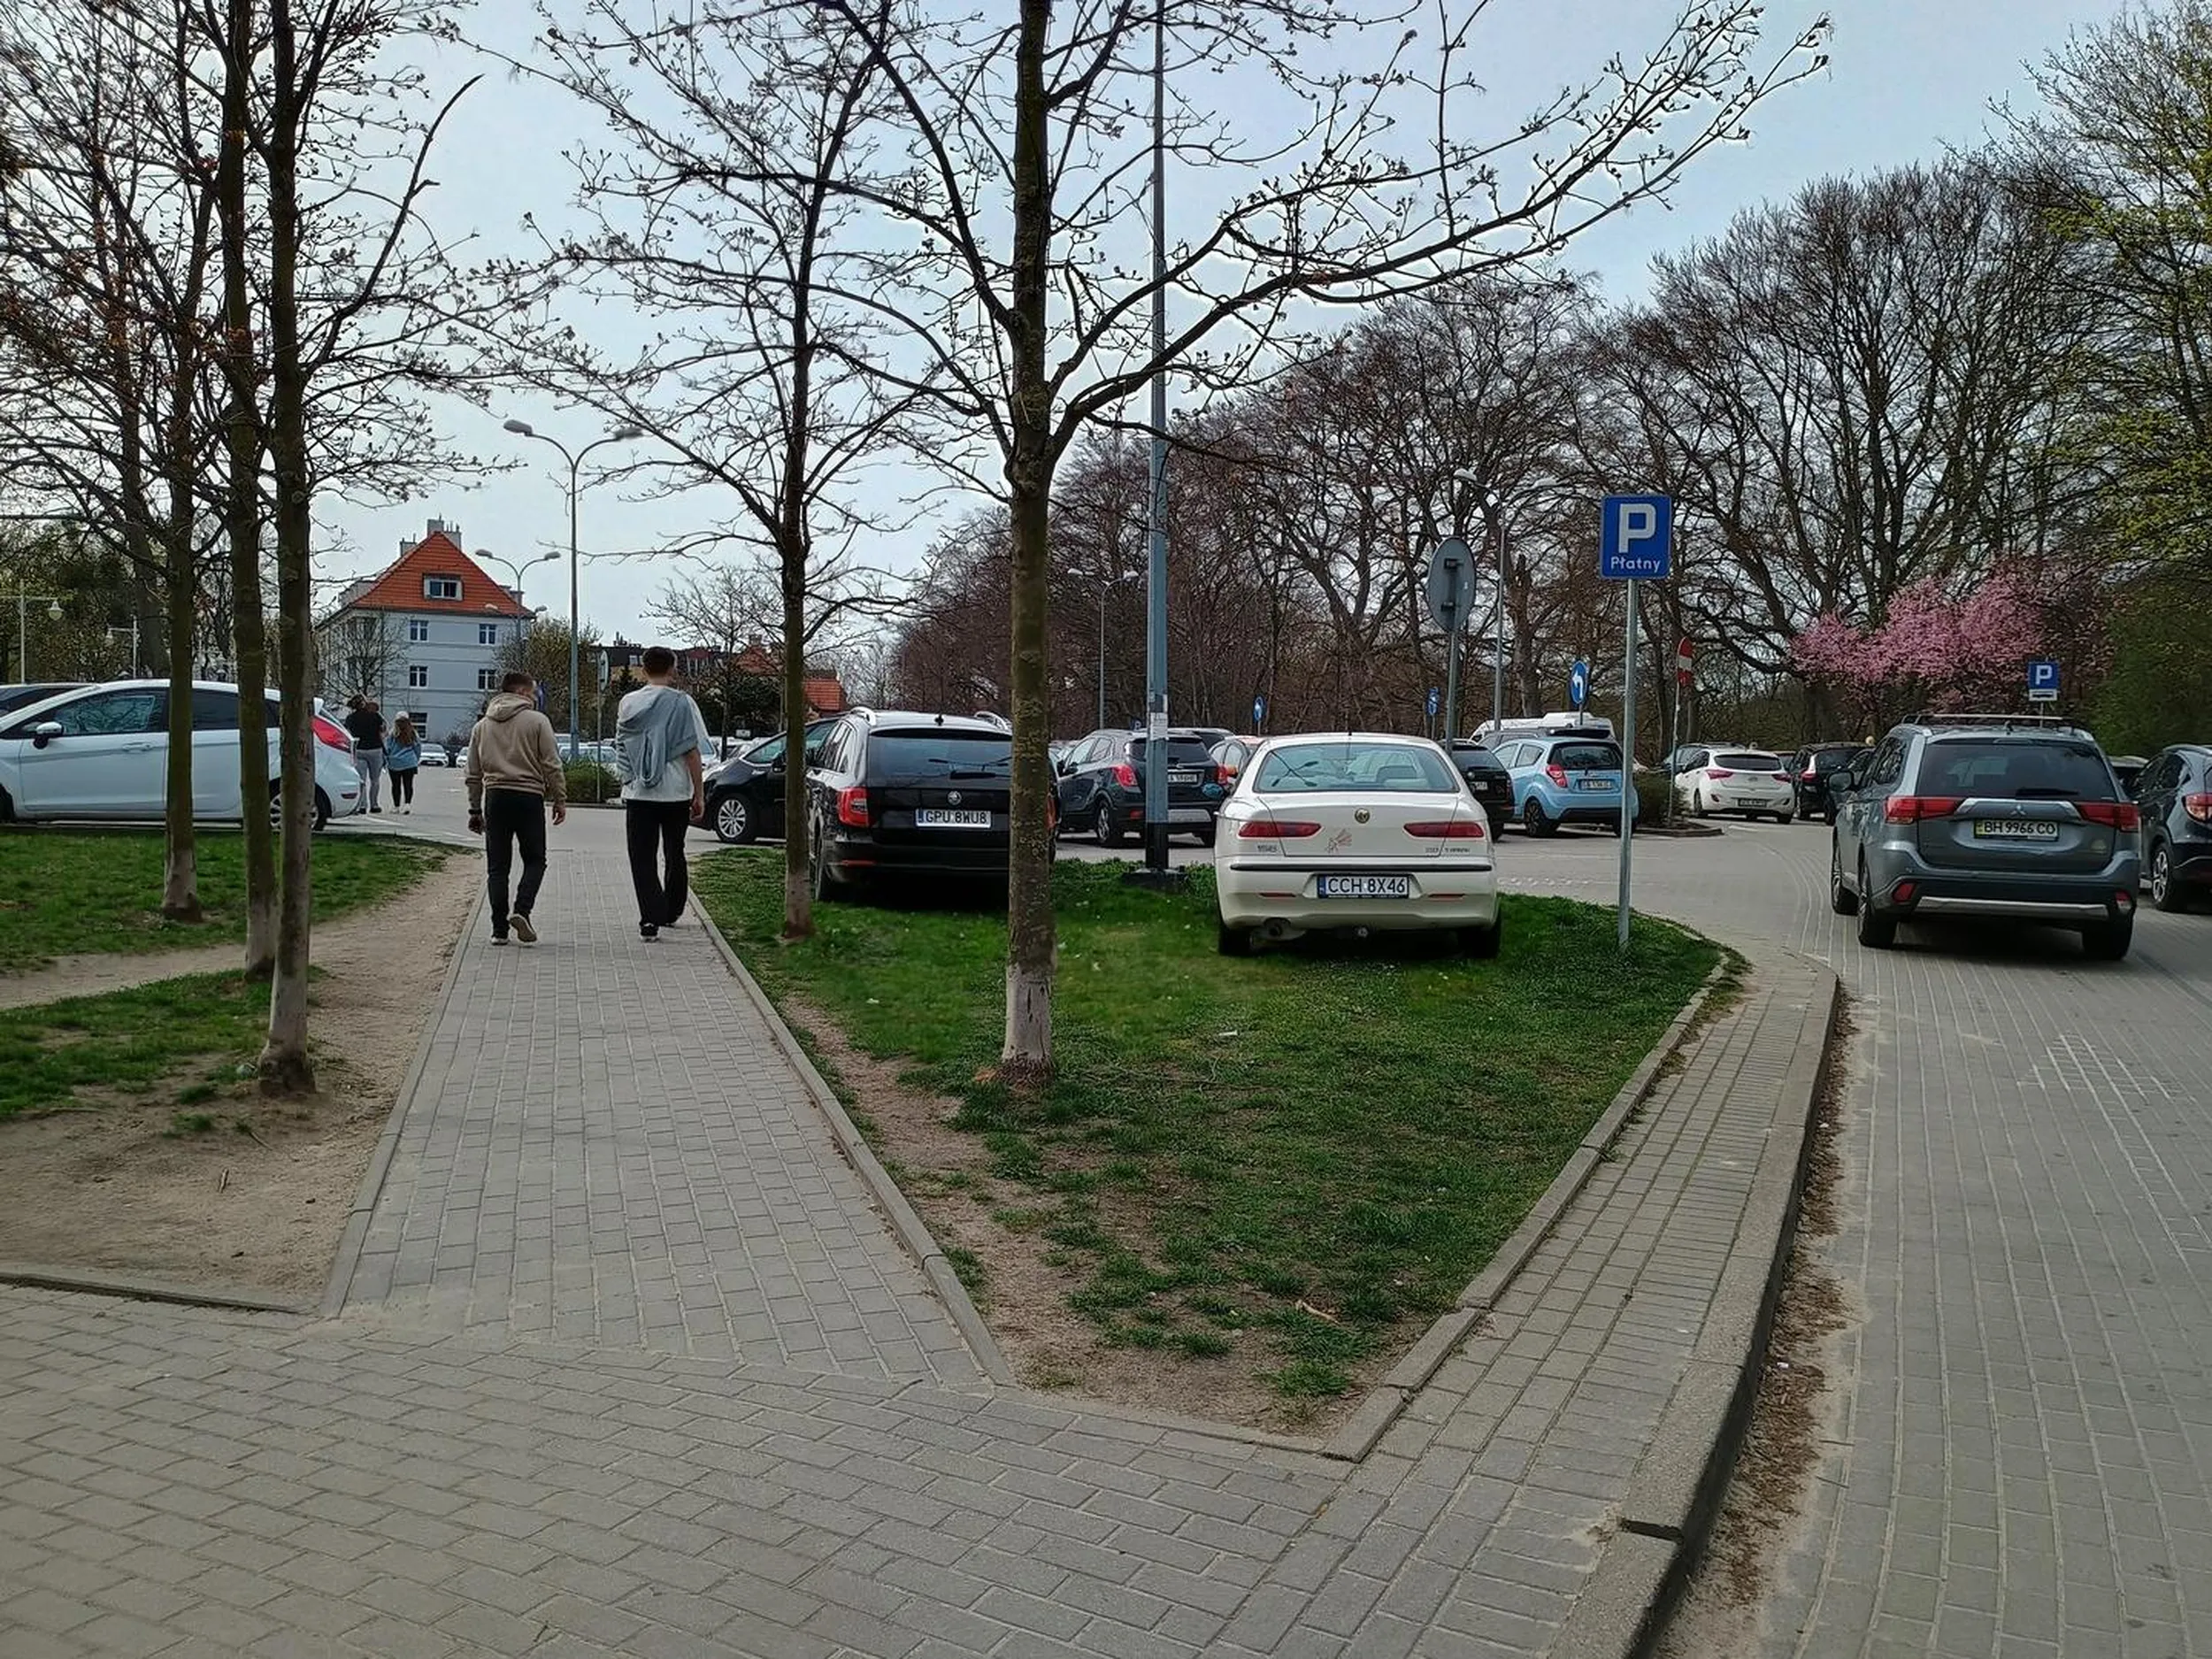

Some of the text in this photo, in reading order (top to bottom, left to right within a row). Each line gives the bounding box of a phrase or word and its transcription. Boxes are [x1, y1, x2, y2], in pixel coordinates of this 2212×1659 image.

[1618, 503, 1656, 553] P
[1610, 556, 1661, 572] Płatny
[2036, 665, 2053, 685] P
[926, 810, 950, 823] GPU
[1985, 821, 2056, 834] BH 9966 CO
[1328, 878, 1405, 894] CCH 8X46
